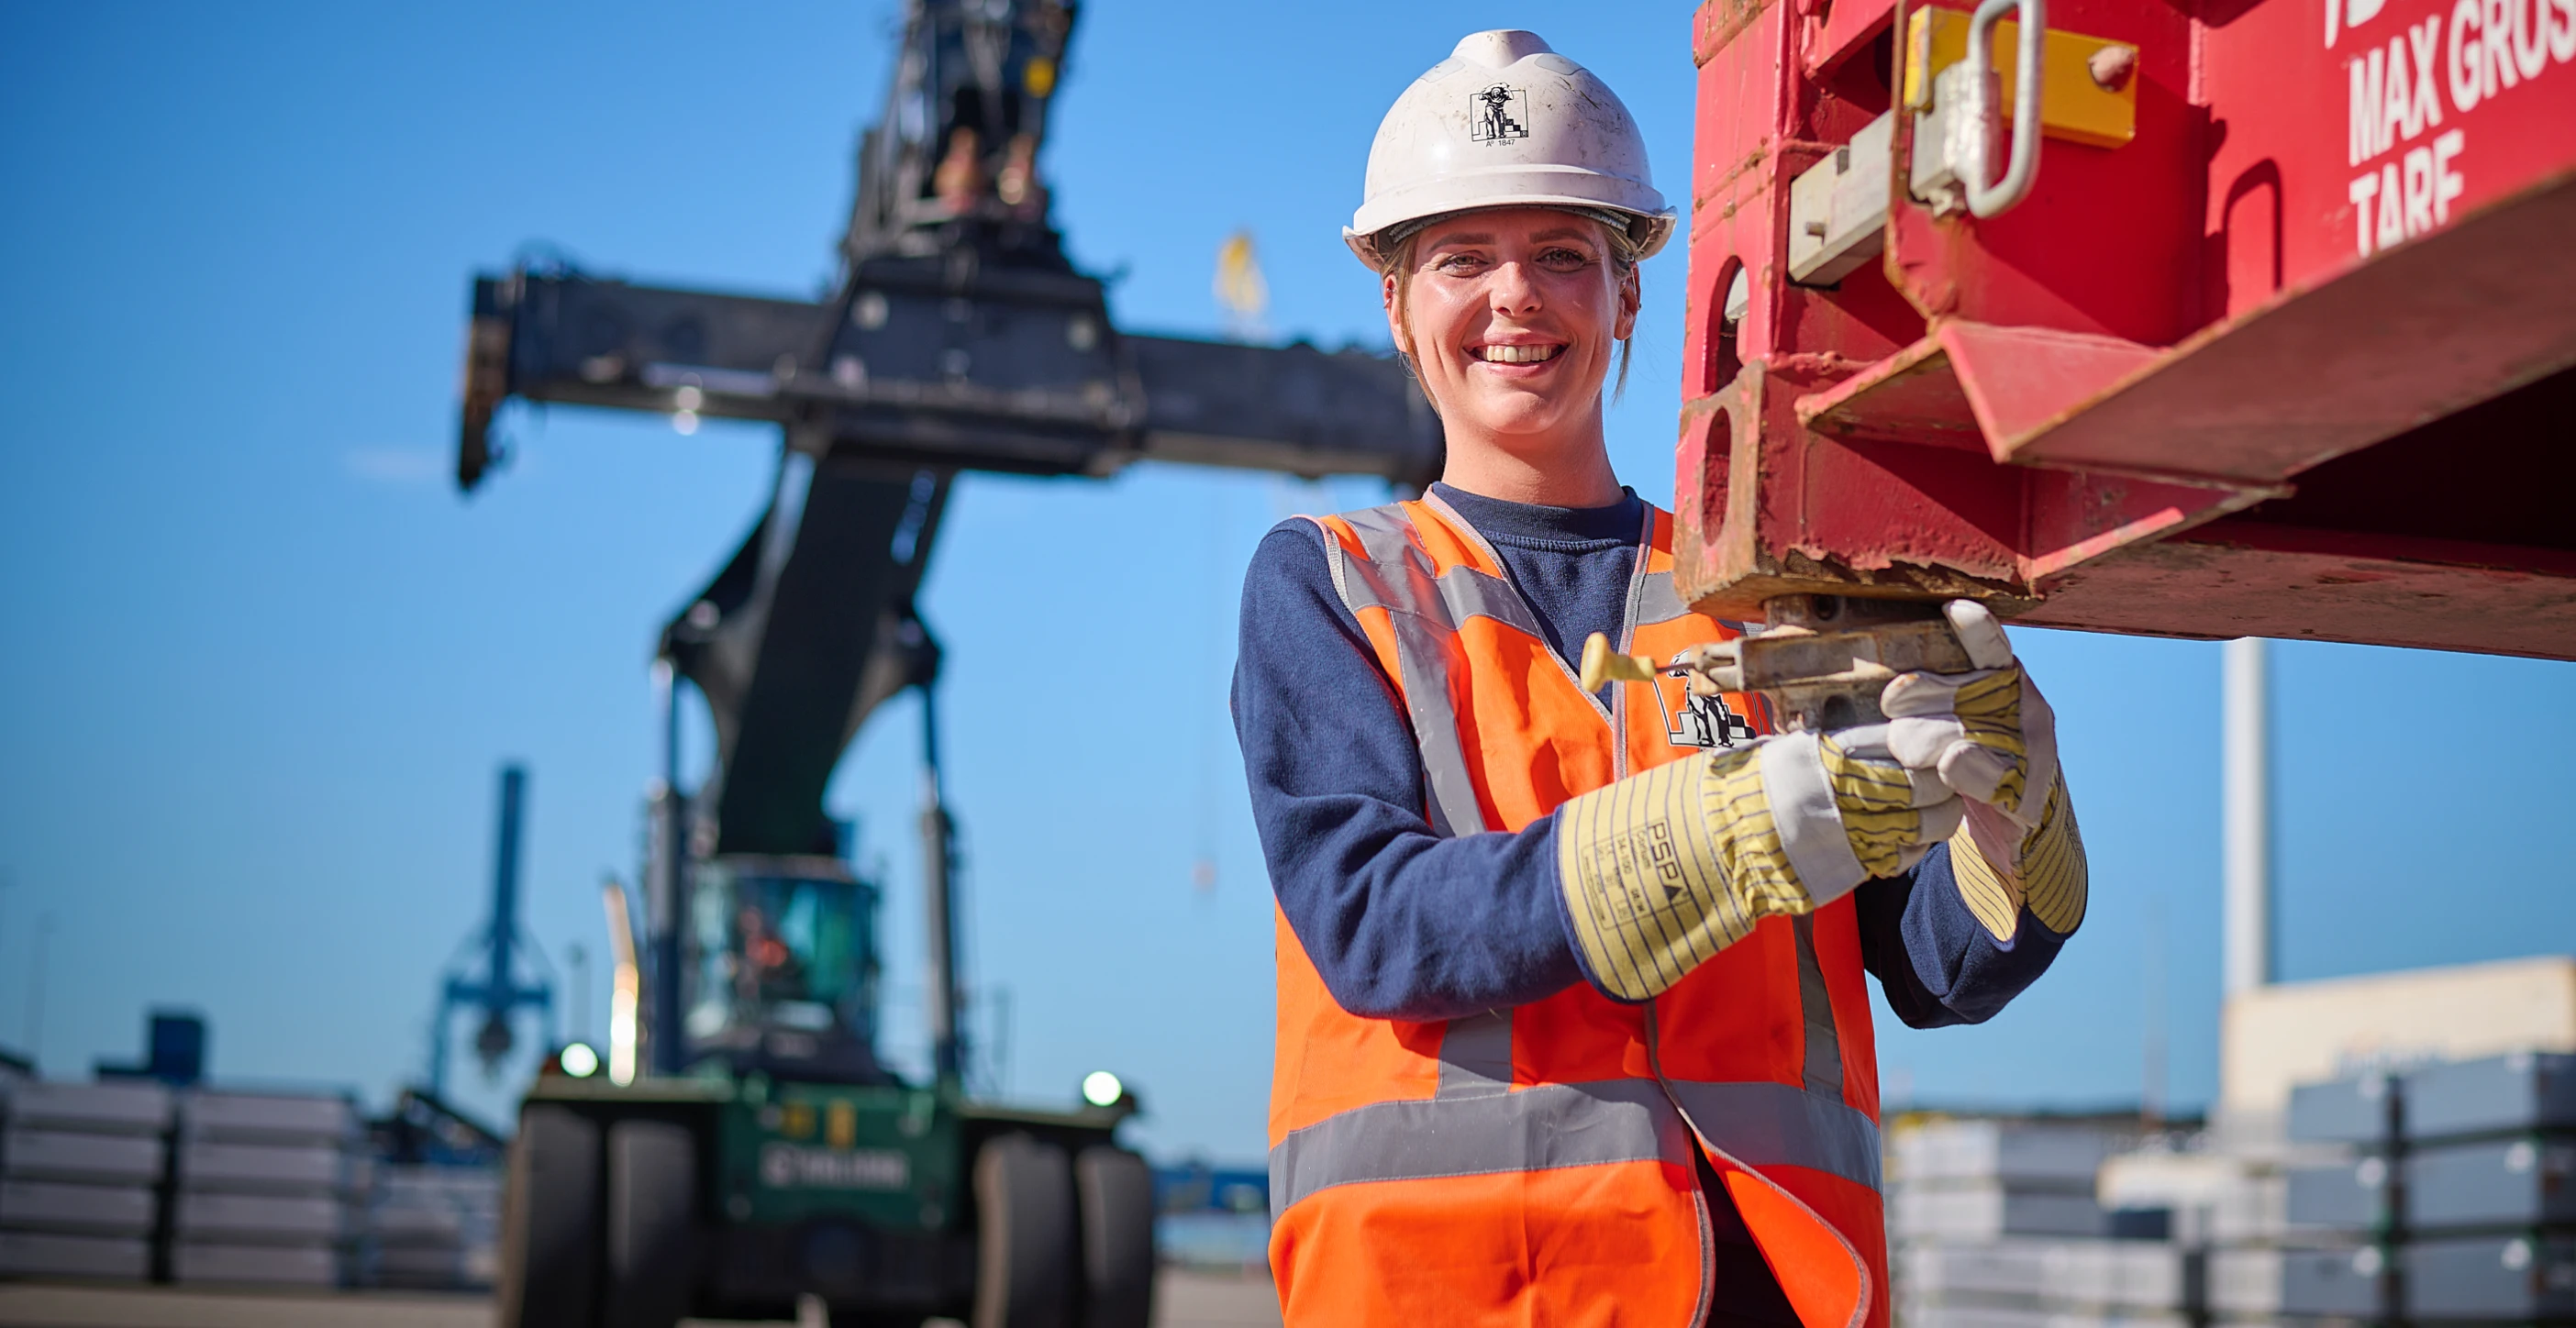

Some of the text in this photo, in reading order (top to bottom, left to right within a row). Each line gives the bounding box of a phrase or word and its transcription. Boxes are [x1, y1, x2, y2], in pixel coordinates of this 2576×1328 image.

[2349, 15, 2441, 167] MAX
[1498, 138, 1516, 147] 1847
[1649, 822, 1679, 880] PSP
